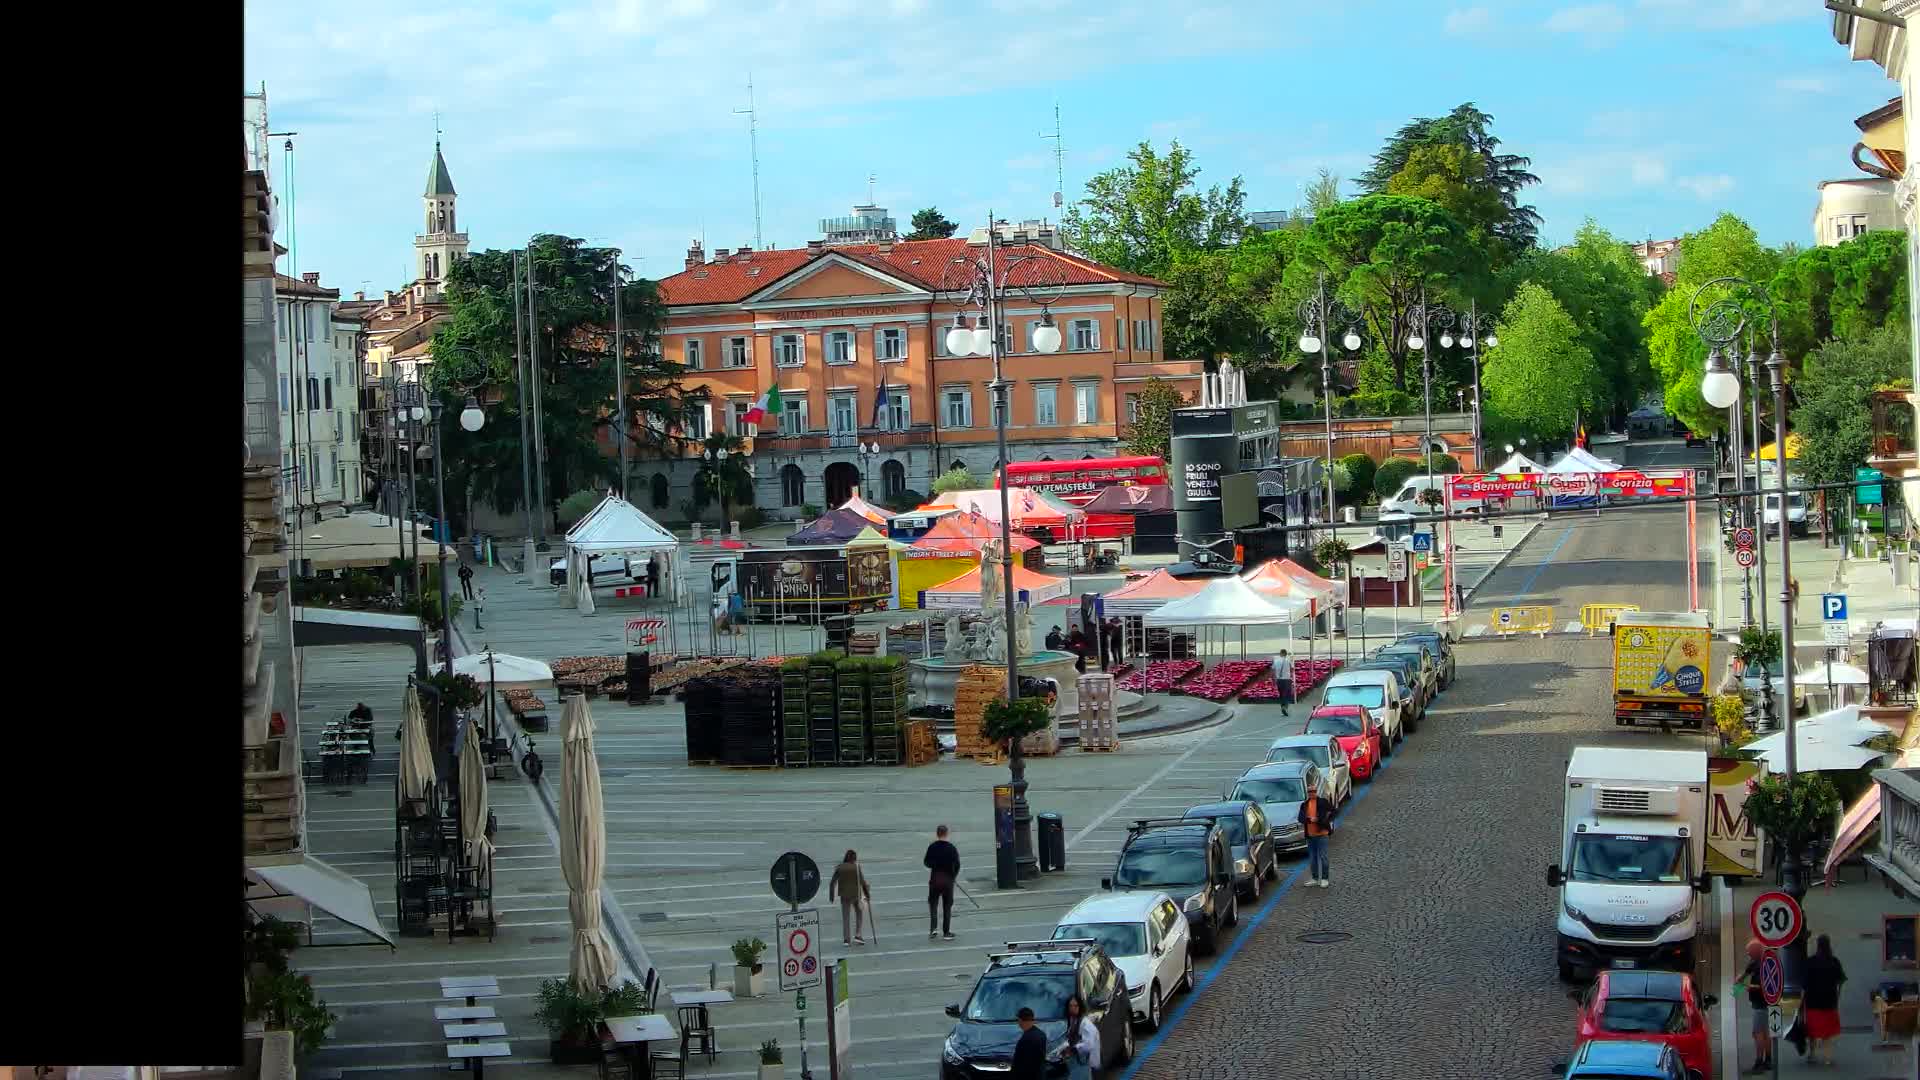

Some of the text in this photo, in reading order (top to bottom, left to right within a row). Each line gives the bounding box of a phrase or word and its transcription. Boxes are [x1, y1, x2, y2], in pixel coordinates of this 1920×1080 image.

[1185, 463, 1221, 472] IO SONO
[1186, 472, 1208, 480] FRIULI
[1185, 480, 1219, 488] VENEZIA
[1472, 480, 1531, 492] Benvenuti
[1611, 478, 1653, 488] Gorizia
[1186, 489, 1213, 497] GIULIA
[1739, 552, 1751, 562] 20
[1827, 598, 1843, 618] P
[1676, 671, 1701, 681] CINQUE
[1679, 677, 1700, 687] STELLE
[1711, 793, 1758, 841] M
[1759, 907, 1790, 932] 30
[787, 963, 796, 973] 20
